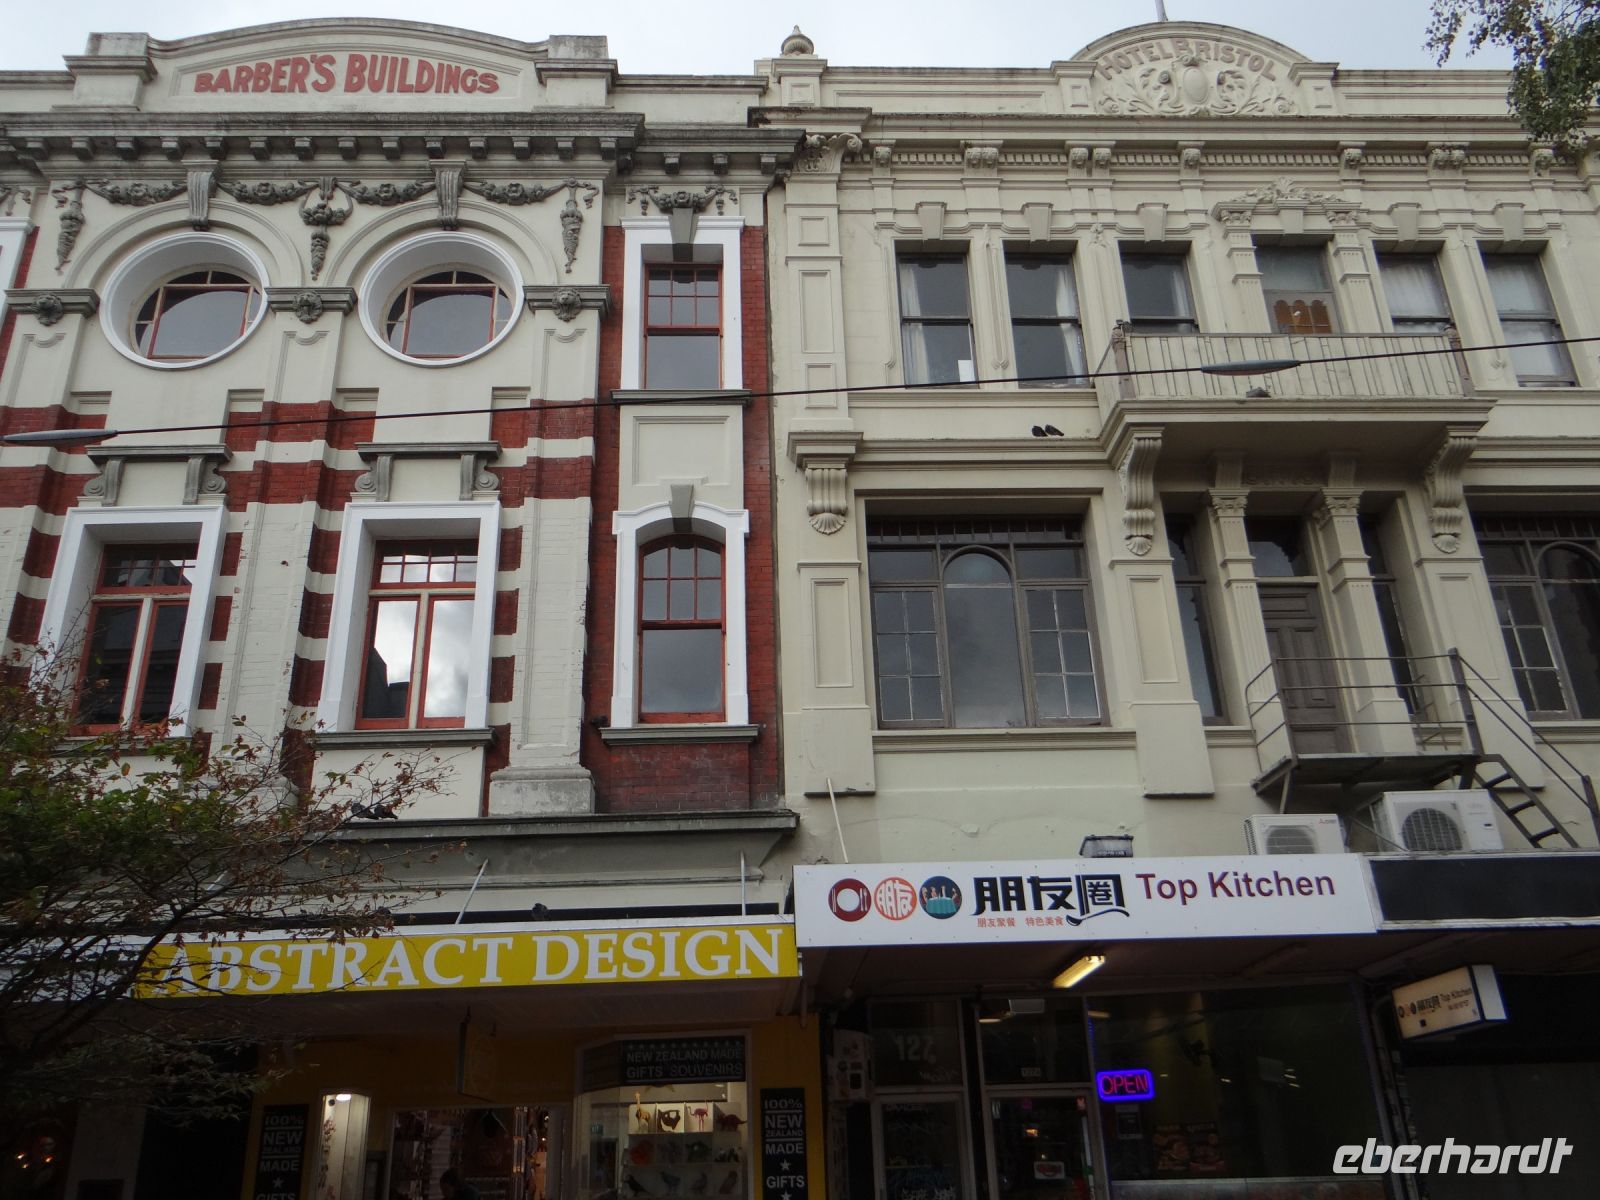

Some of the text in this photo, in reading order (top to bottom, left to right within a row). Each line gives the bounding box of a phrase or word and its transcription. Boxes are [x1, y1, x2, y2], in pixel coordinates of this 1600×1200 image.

[1097, 38, 1276, 81] HOTEL BRISTOL
[195, 53, 499, 94] BARBER'S BUILDINGS
[971, 874, 1126, 917] 朋友圈
[1135, 870, 1336, 907] Top Kitchen
[152, 929, 784, 994] ABSTRACT DESIGN
[626, 1052, 653, 1063] NEW
[655, 1049, 708, 1062] ZEALAND
[626, 1063, 744, 1079] GIFTS SOUVENIRS
[1101, 1074, 1149, 1095] OPEN
[764, 1098, 803, 1110] 100%
[764, 1114, 804, 1129] NEW
[263, 1131, 304, 1145] NEW
[765, 1143, 804, 1155] MADE
[260, 1160, 299, 1172] MADE
[766, 1175, 805, 1189] GIFTS
